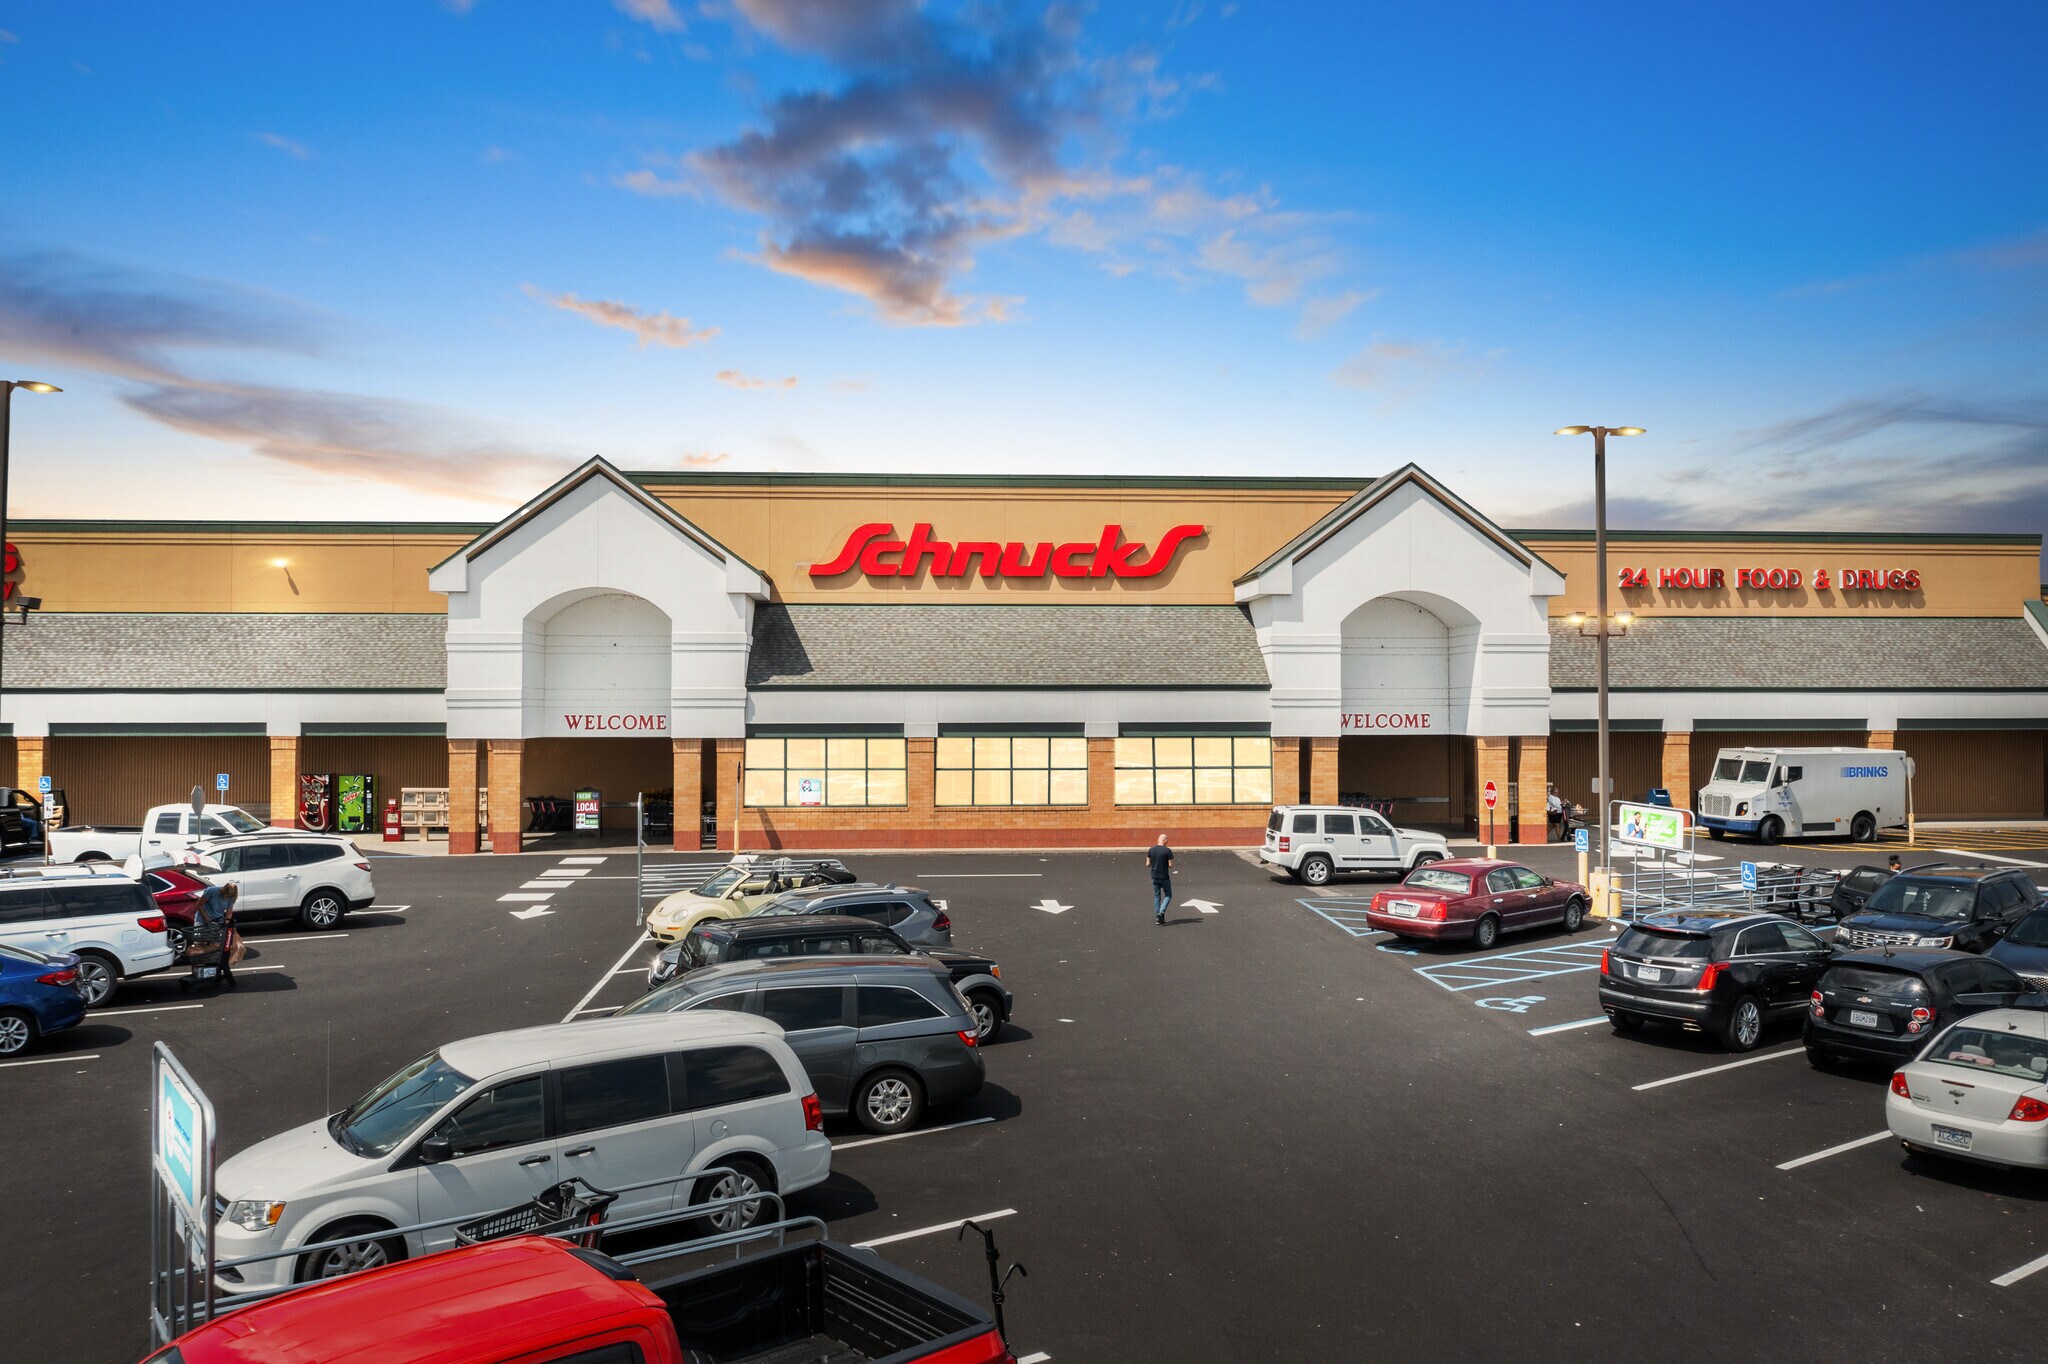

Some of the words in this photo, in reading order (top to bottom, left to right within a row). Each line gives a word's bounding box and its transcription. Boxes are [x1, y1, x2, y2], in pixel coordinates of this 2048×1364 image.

[808, 522, 1204, 577] Schnucks
[1618, 567, 1649, 588] 24
[1656, 567, 1725, 589] HOUR
[1734, 567, 1803, 590] FOOD
[1812, 569, 1831, 590] &
[1839, 568, 1921, 590] DRUGS
[564, 714, 667, 731] WELCOME
[1341, 713, 1431, 729] WELCOME
[1849, 766, 1888, 778] BRINKS
[1485, 788, 1496, 801] STOP
[576, 802, 599, 812] LOCAL
